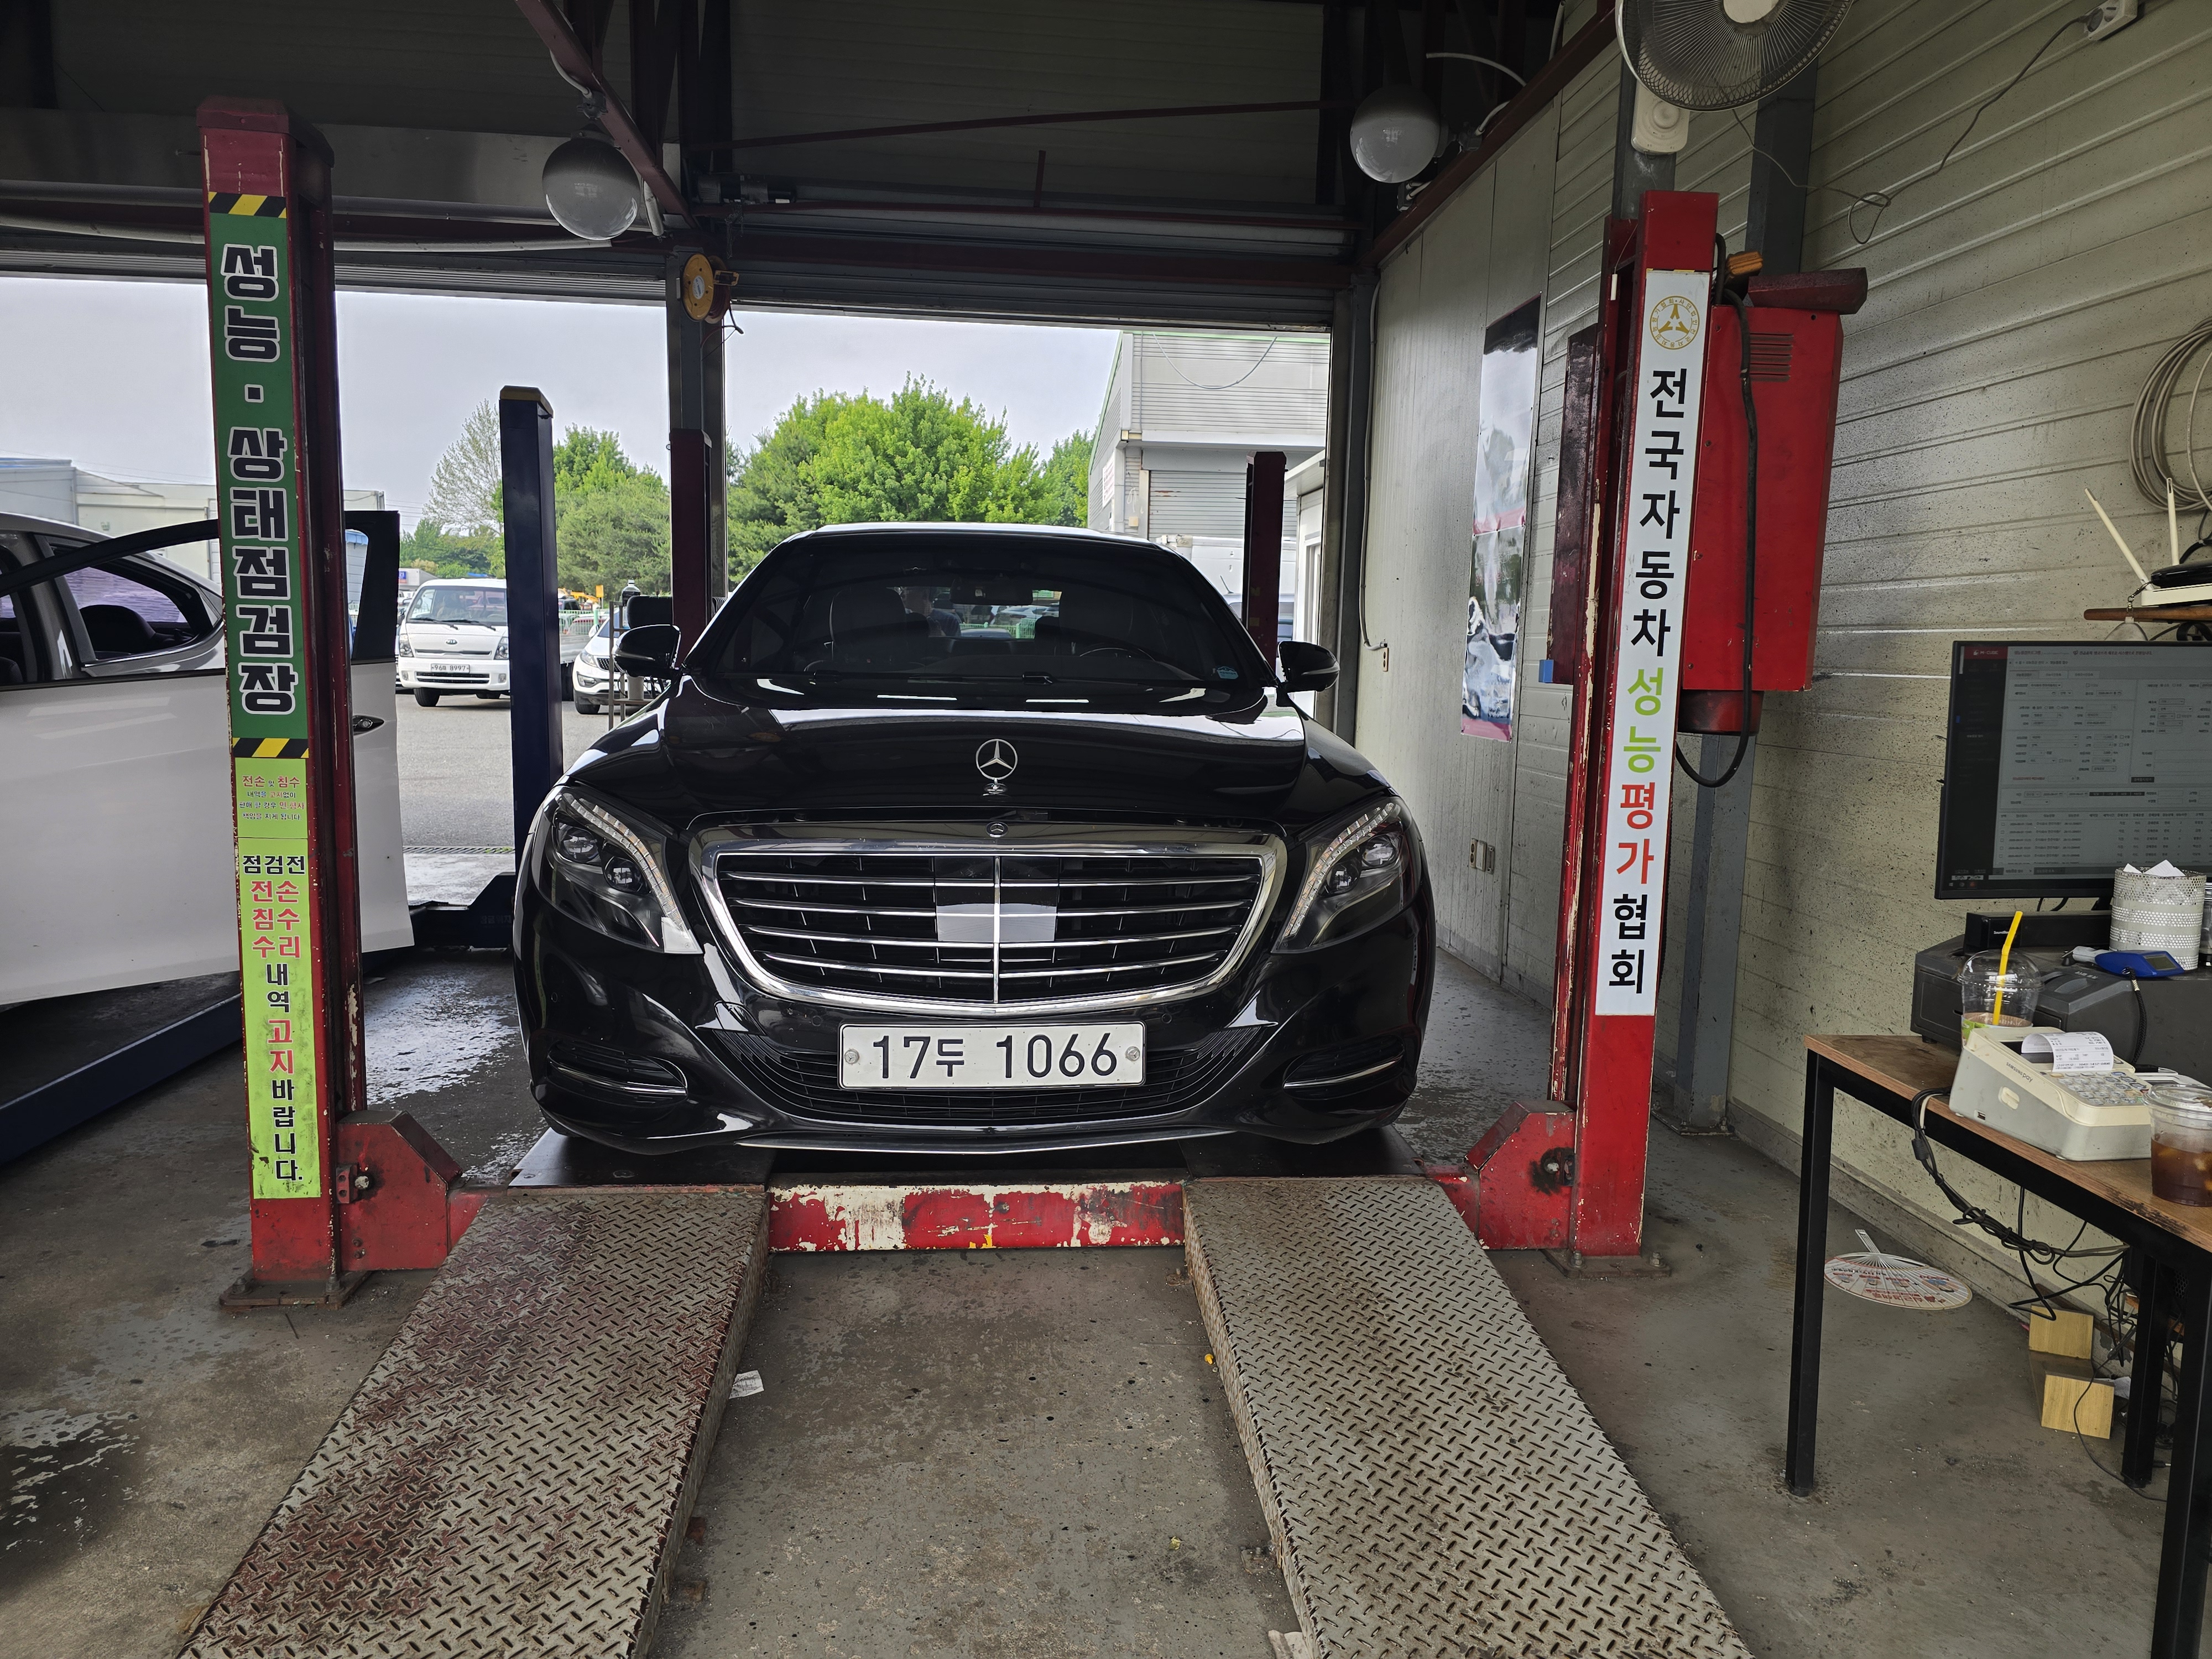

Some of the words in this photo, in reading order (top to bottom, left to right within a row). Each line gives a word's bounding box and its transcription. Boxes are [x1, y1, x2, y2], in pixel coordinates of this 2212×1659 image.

[221, 243, 279, 362] 성능
[228, 427, 295, 715] 상태점검장
[242, 775, 265, 787] 전손
[278, 776, 300, 788] 침수
[242, 855, 306, 874] 점검전
[250, 880, 299, 903] 전손
[252, 908, 301, 931] 침수
[252, 936, 301, 959] 수리
[872, 1035, 964, 1079] 17두
[996, 1032, 1118, 1079] 1066
[2006, 1062, 2023, 1076] SAMSUNG
[2022, 1073, 2033, 1082] pay
